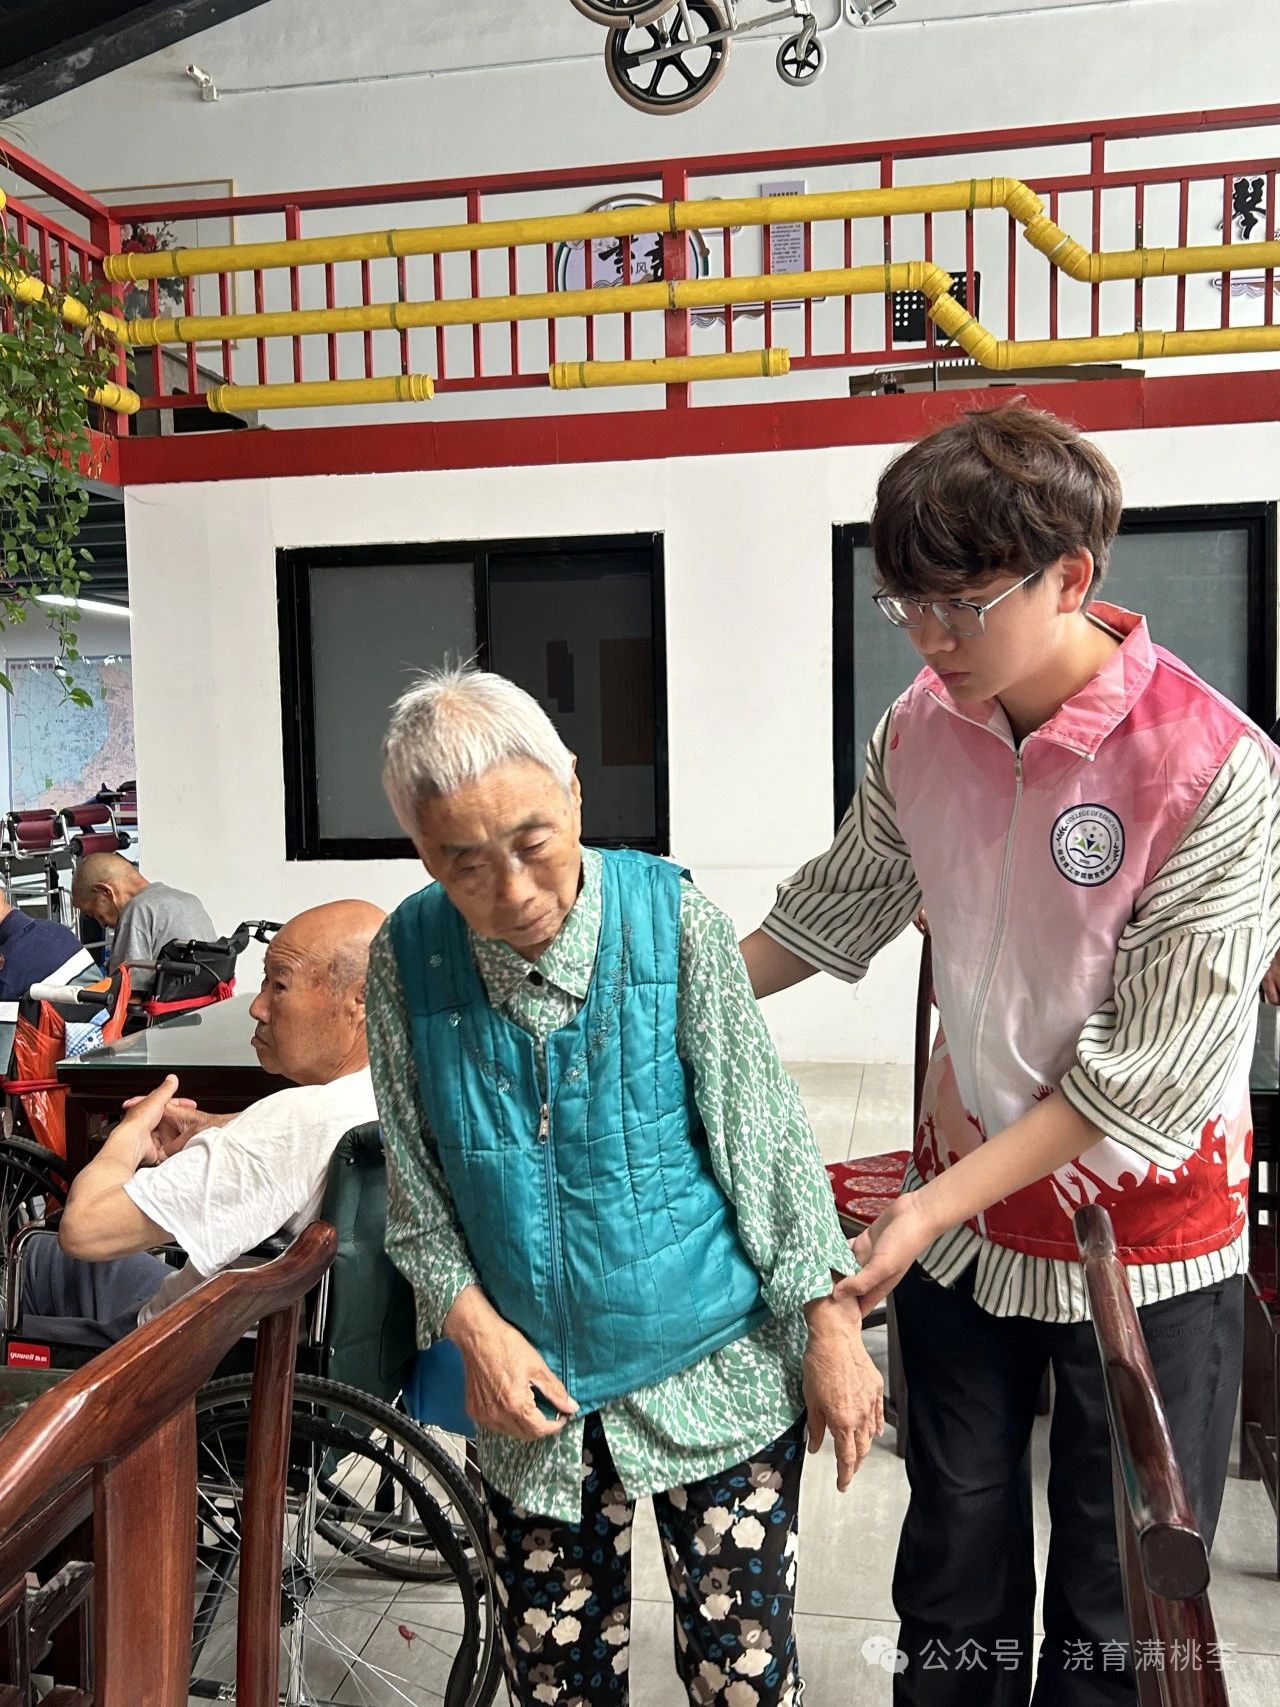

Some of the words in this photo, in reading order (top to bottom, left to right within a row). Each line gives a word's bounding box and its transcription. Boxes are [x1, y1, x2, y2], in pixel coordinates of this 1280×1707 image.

[636, 262, 648, 275] 风
[1065, 810, 1090, 825] COLLEGE
[1098, 812, 1120, 842] EDUCATION
